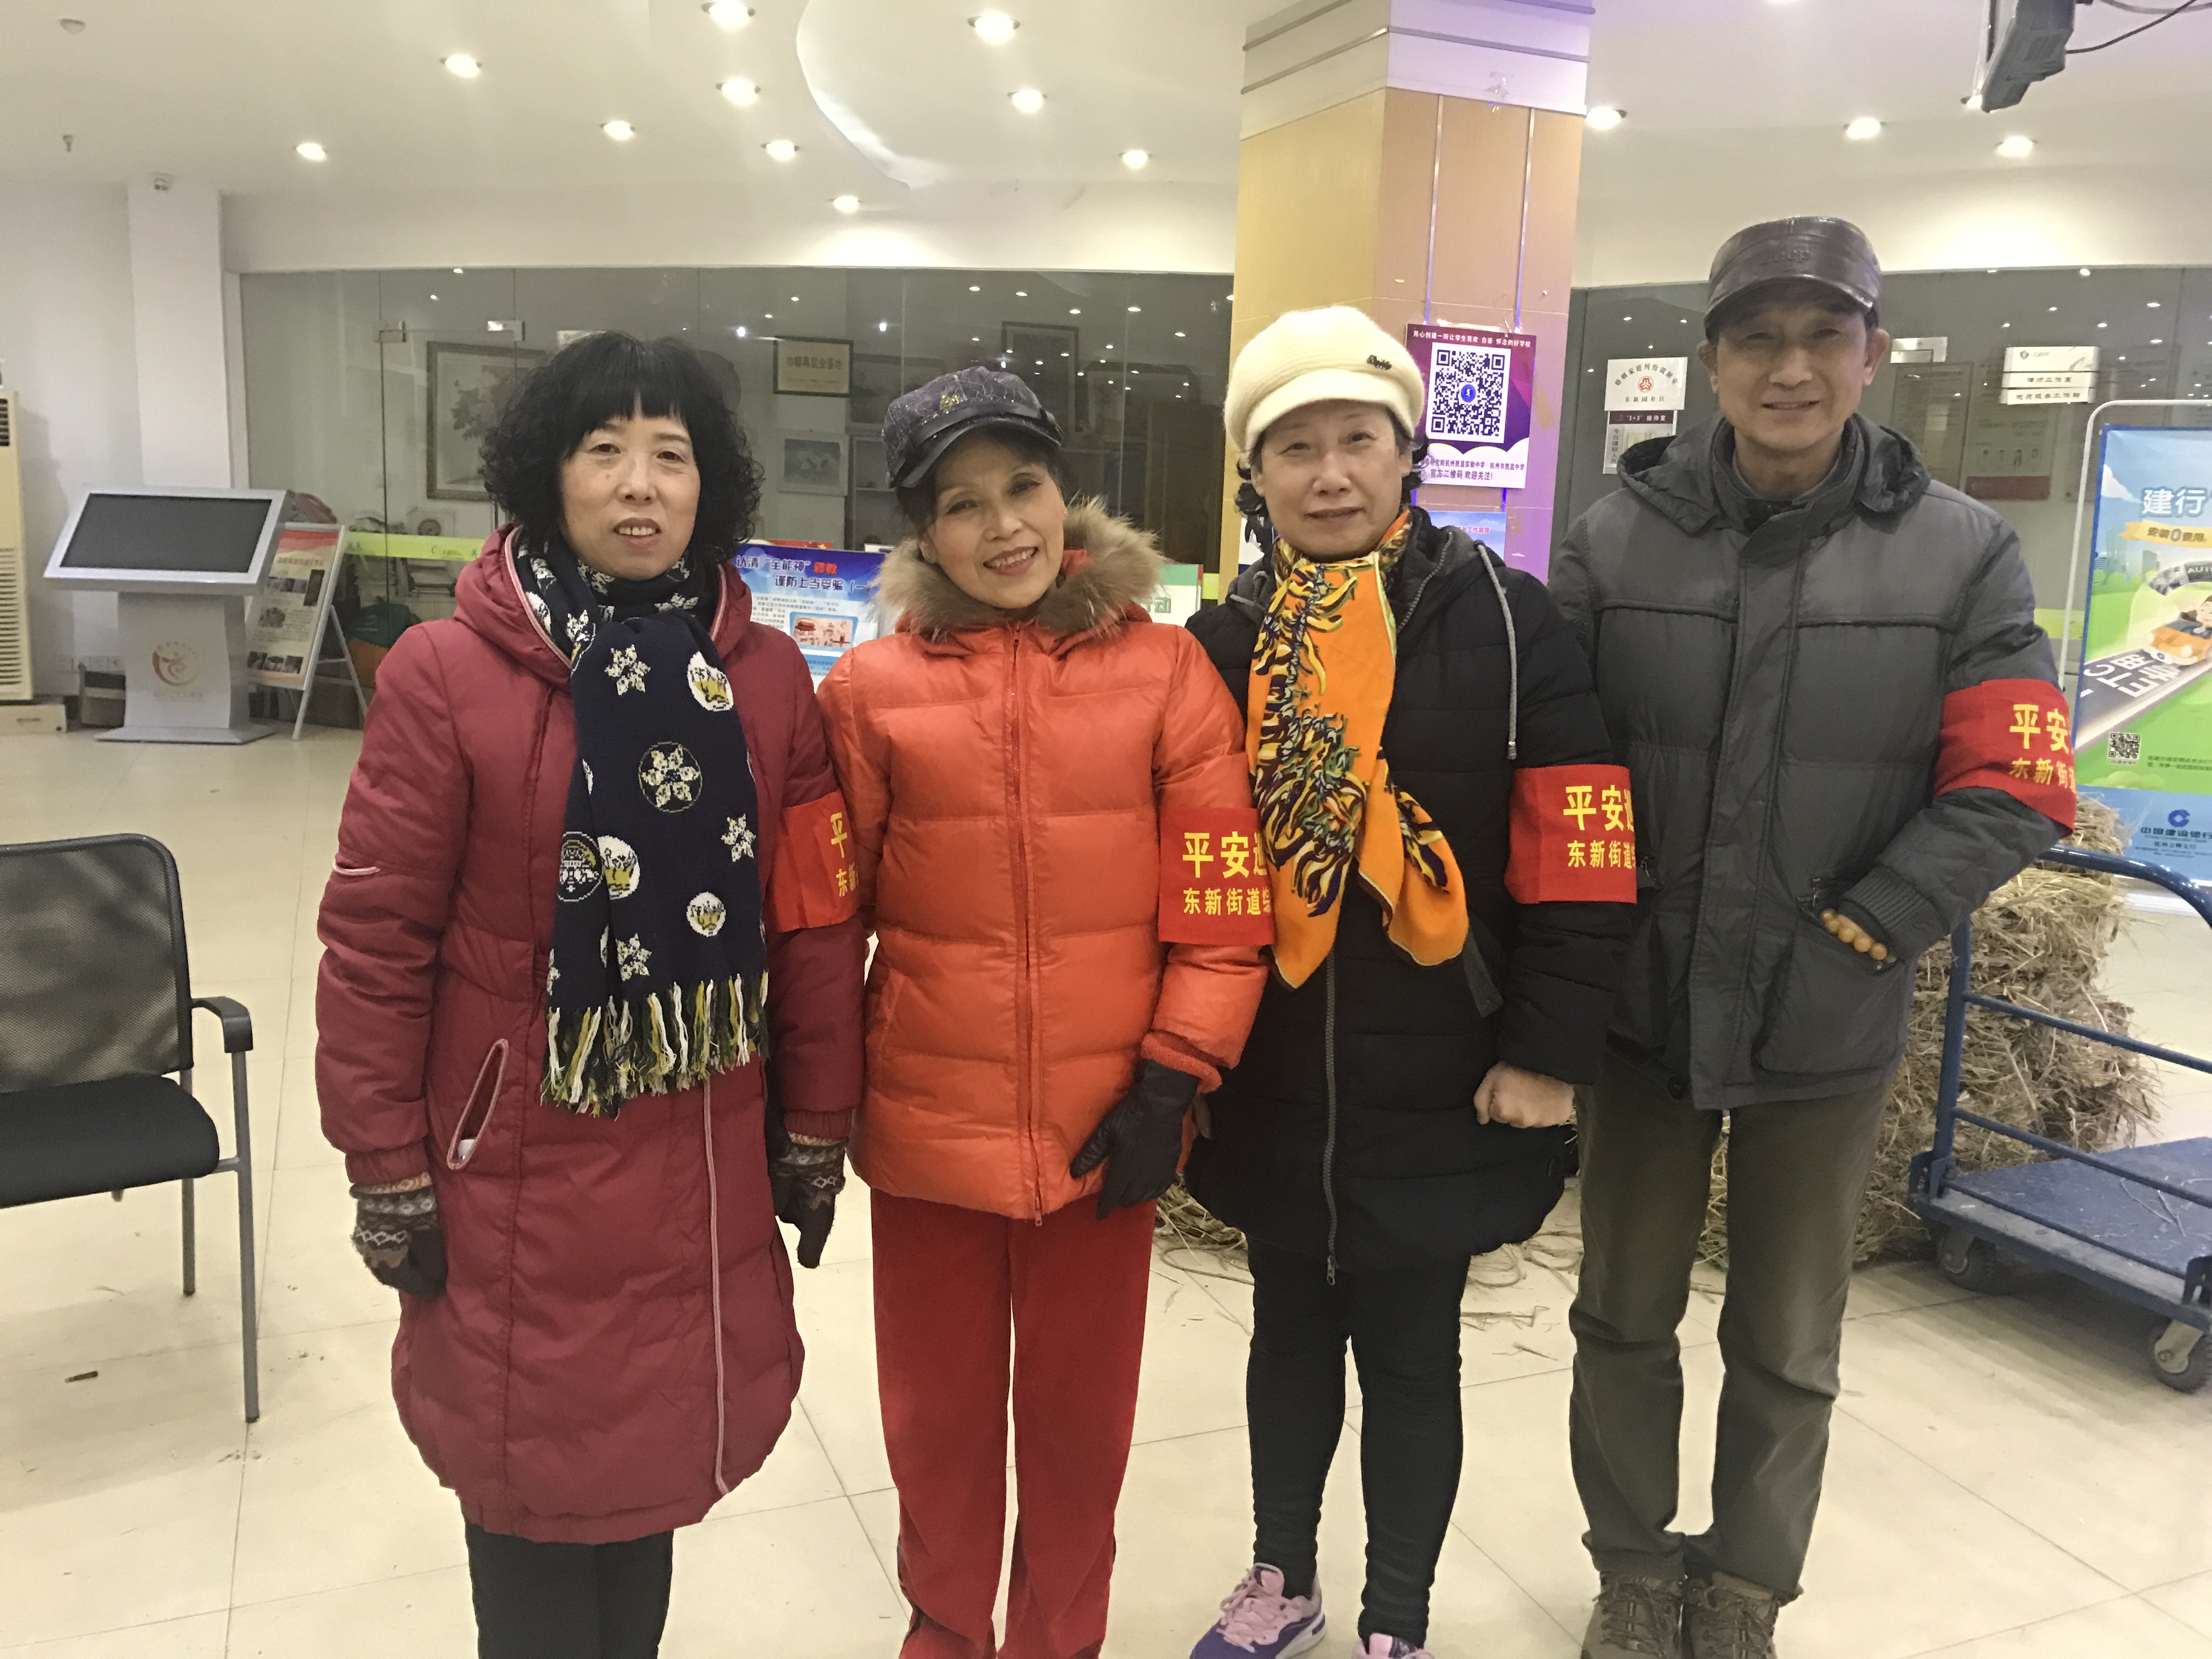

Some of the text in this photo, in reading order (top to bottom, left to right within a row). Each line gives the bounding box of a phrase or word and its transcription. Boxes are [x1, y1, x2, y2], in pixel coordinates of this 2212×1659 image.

[1496, 338, 1531, 348] 怀念的好学校
[1430, 469, 1462, 479] 官方二维码
[2142, 488, 2206, 515] 建行
[2010, 704, 2069, 755] 平安
[830, 812, 848, 858] 平
[2141, 827, 2212, 839] 中国建设银行
[1567, 840, 1636, 869] 东新街道
